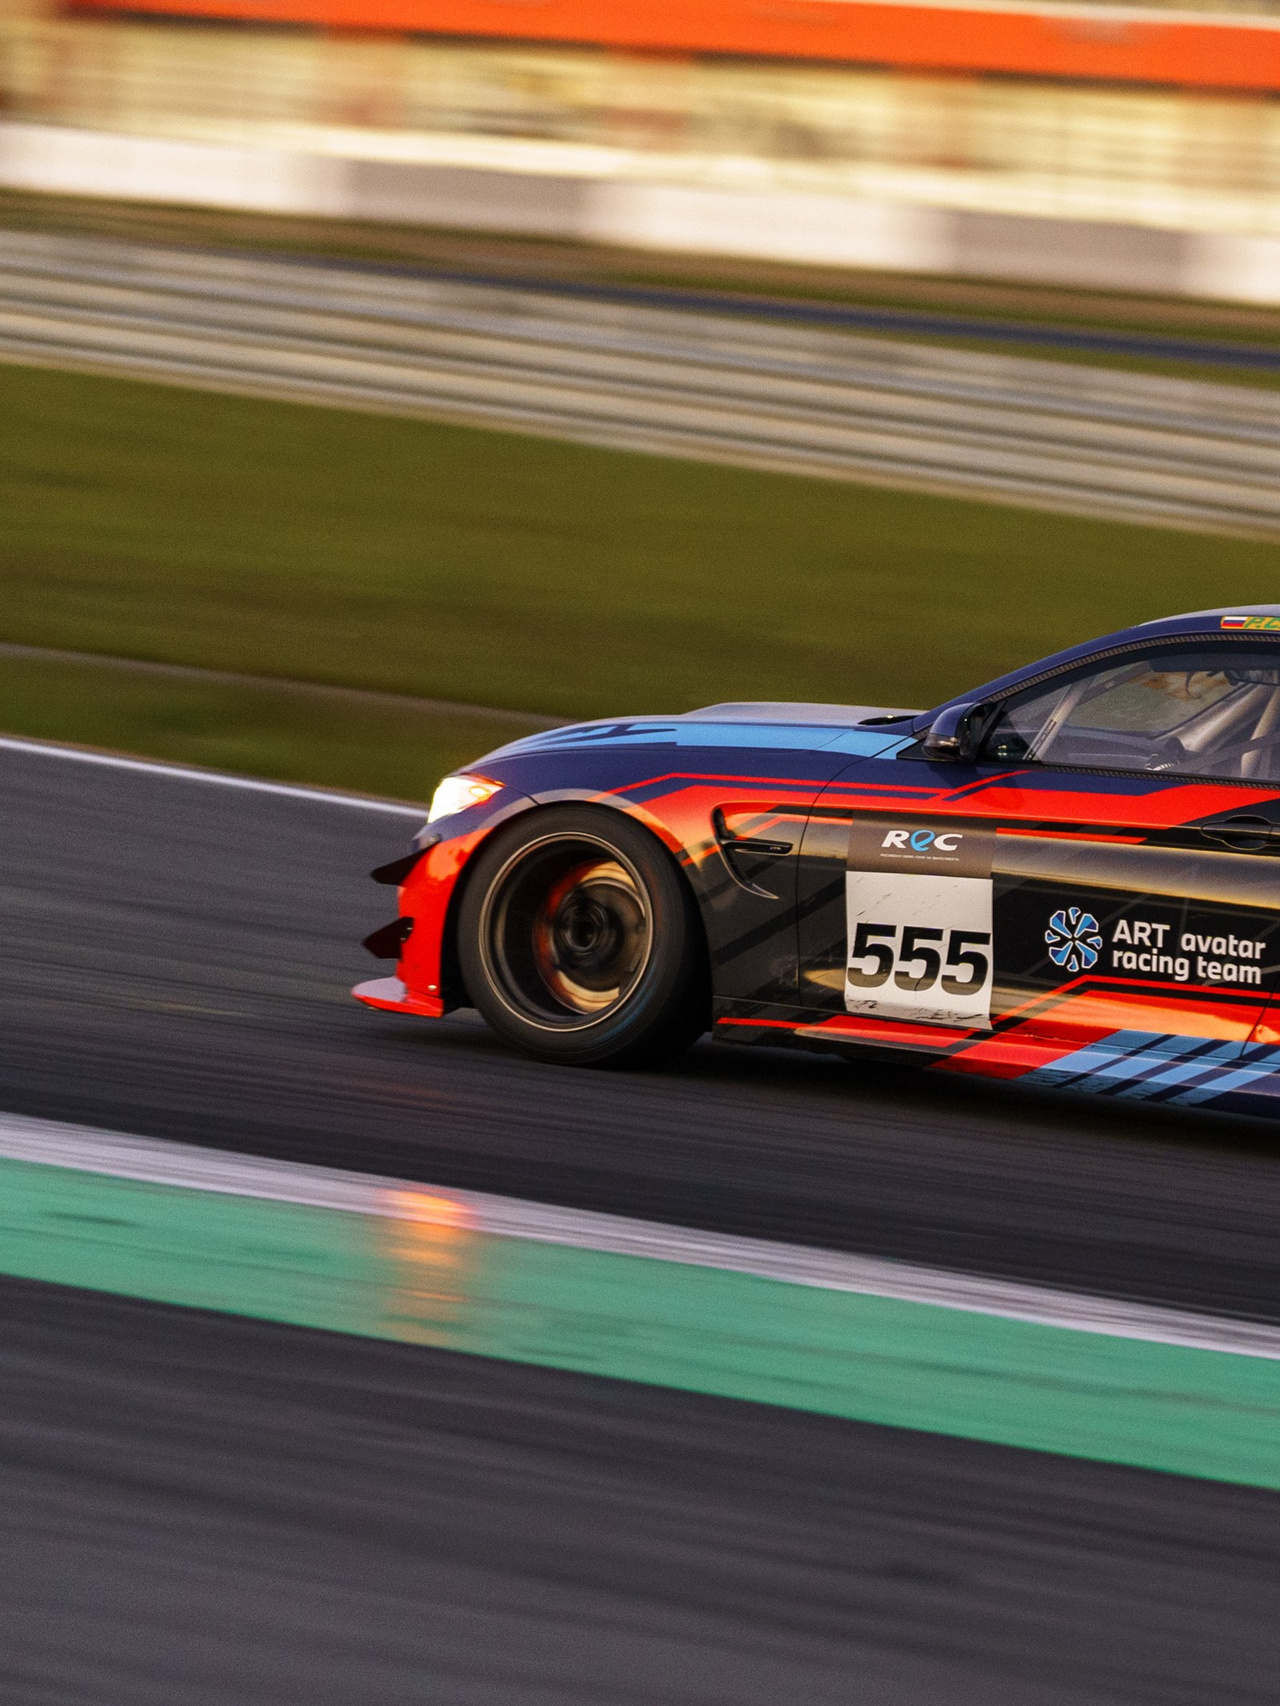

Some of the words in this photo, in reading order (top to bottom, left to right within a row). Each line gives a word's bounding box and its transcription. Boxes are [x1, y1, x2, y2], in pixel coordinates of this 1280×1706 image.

[847, 922, 992, 996] 555
[1112, 919, 1171, 948] ART
[1180, 932, 1266, 960] avatar
[1112, 949, 1190, 981] racing
[1196, 956, 1262, 985] team
